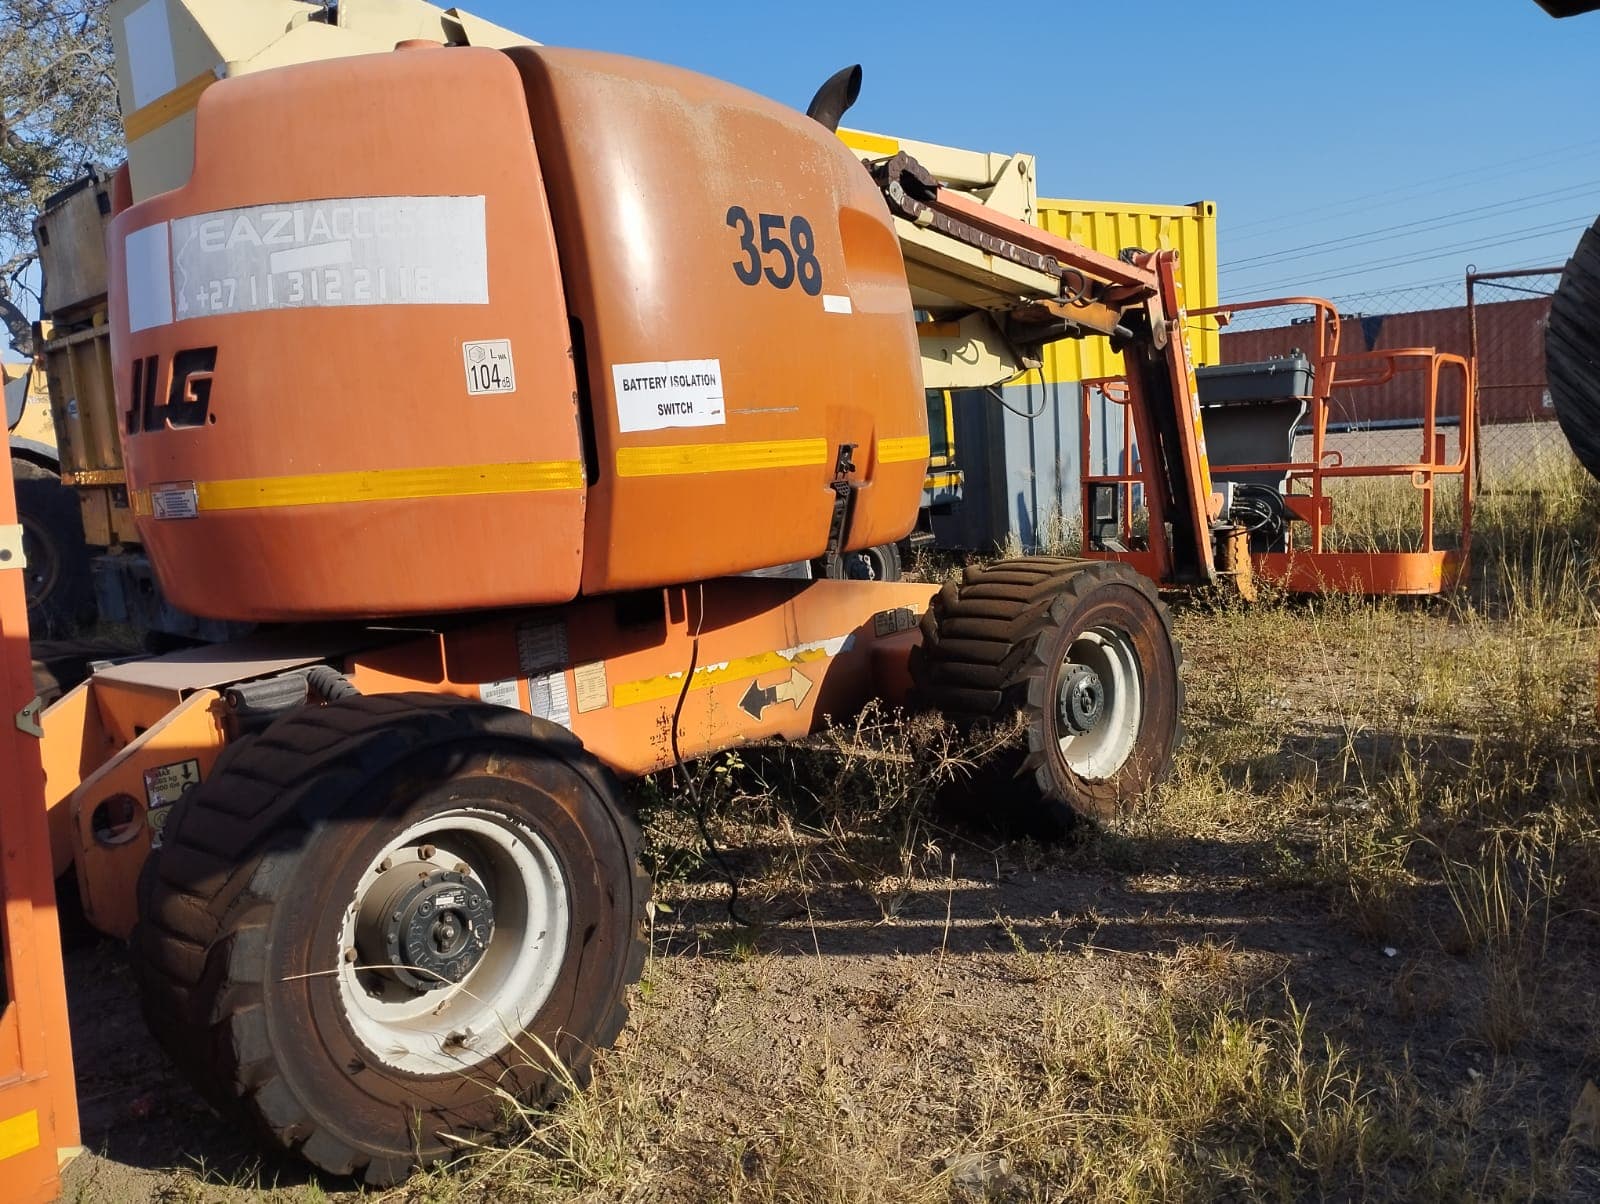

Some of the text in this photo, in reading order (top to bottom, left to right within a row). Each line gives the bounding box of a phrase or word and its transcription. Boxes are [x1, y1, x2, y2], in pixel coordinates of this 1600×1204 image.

[726, 205, 823, 296] 358
[287, 269, 343, 302] 312
[471, 363, 501, 390] 104
[622, 373, 717, 392] BATTERY ISOLATION
[657, 401, 694, 416] SWITCH
